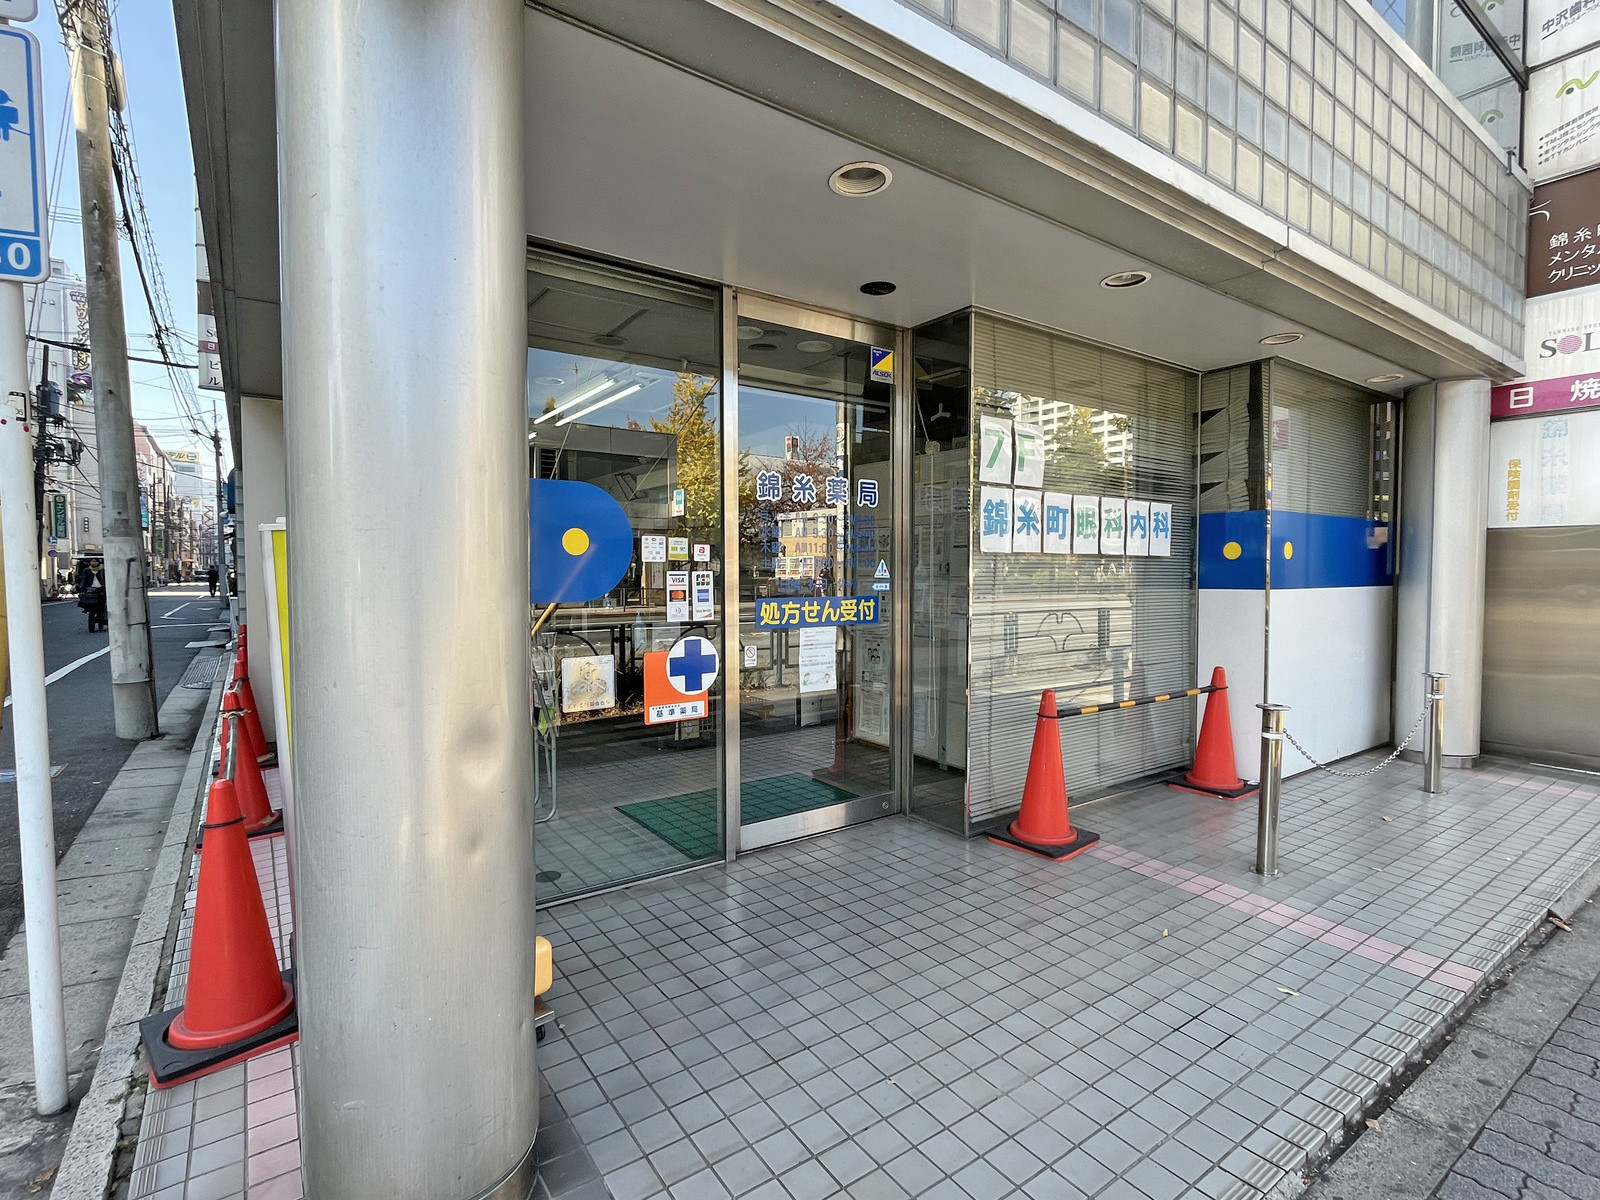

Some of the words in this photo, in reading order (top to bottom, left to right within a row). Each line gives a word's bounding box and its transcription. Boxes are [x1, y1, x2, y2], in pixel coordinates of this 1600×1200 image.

[1548, 223, 1600, 250] 錦糸
[872, 370, 892, 379] ALSOK
[984, 428, 1036, 472] 7F
[757, 470, 878, 507] 錦糸薬局
[983, 499, 1170, 540] 錦糸町眼科内科
[759, 598, 877, 626] 処方せん受付
[656, 705, 699, 718] 基準薬局
